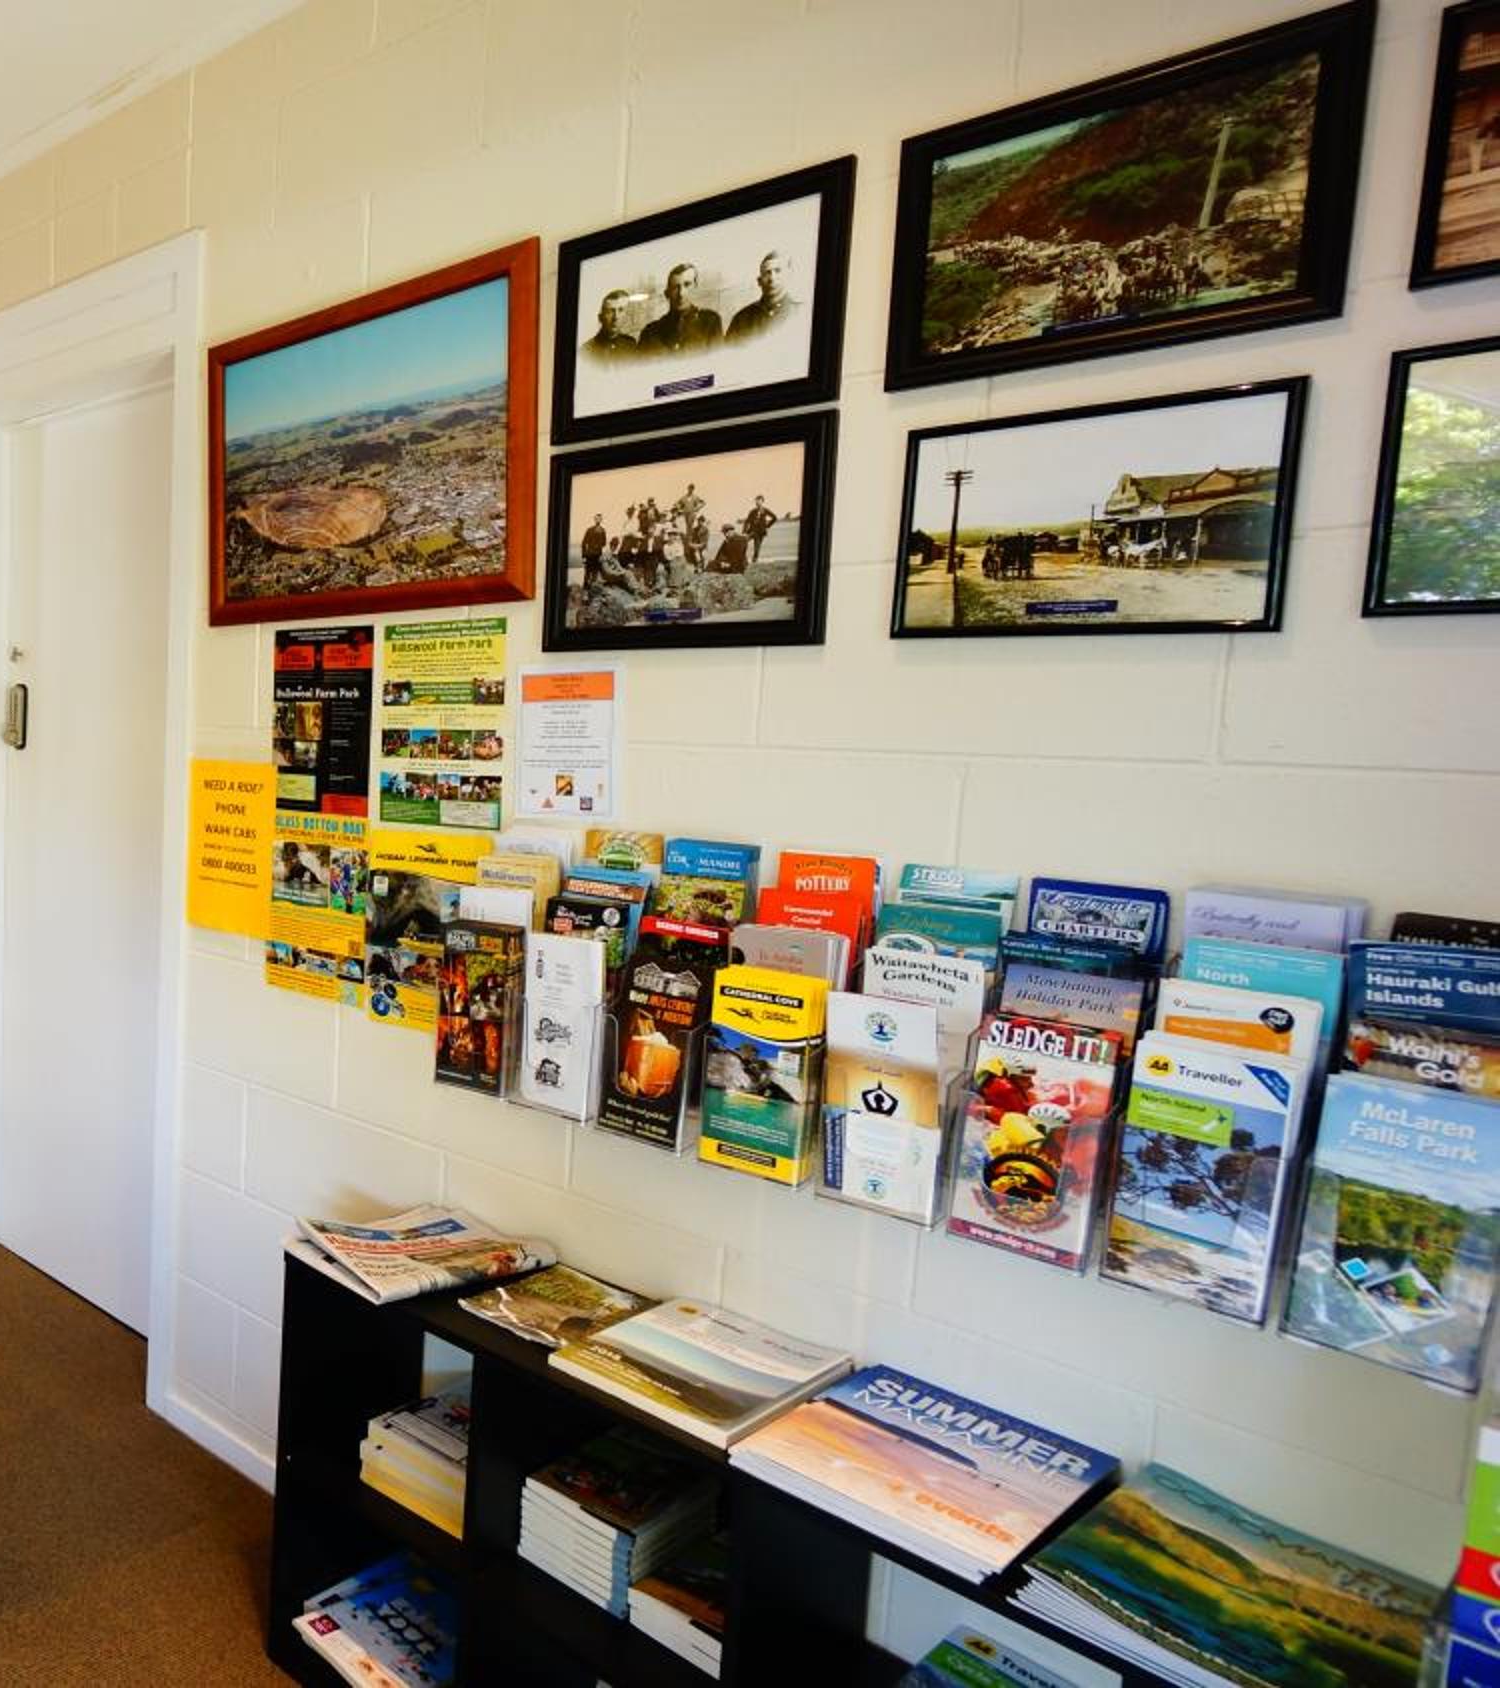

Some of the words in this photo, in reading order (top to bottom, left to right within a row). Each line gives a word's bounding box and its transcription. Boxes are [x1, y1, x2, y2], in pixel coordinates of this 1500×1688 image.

[440, 639, 467, 650] Farm
[469, 638, 493, 649] Park
[315, 687, 338, 698] Farm
[339, 687, 360, 699] Park
[203, 779, 227, 791] NEED
[228, 781, 235, 791] A
[236, 781, 264, 793] RIDE?
[215, 802, 247, 816] PHONE
[234, 825, 257, 839] CABS
[1040, 920, 1142, 942] CHARTERS
[871, 952, 970, 984] Waitawheta
[1366, 951, 1393, 962] Free
[883, 970, 957, 994] Gardens
[1196, 966, 1251, 986] North
[1366, 973, 1451, 992] Hauraki
[1457, 979, 1500, 996] Gulf
[776, 993, 800, 1008] COVE
[1015, 988, 1074, 1011] Holiday
[1077, 998, 1117, 1015] Park
[1366, 989, 1445, 1009] Islands
[988, 1019, 1066, 1057] SLEDGE
[1071, 1034, 1109, 1066] IT!
[1148, 1059, 1171, 1073] AA
[1177, 1064, 1245, 1089] Traveller
[1414, 1061, 1484, 1089] Gold
[1360, 1100, 1477, 1140] McLaren
[1349, 1120, 1411, 1149] Falls
[1415, 1135, 1478, 1164] Park
[867, 1376, 1093, 1481] SUMMER
[852, 1388, 1080, 1493] MAGAZINE
[915, 1491, 1018, 1545] events
